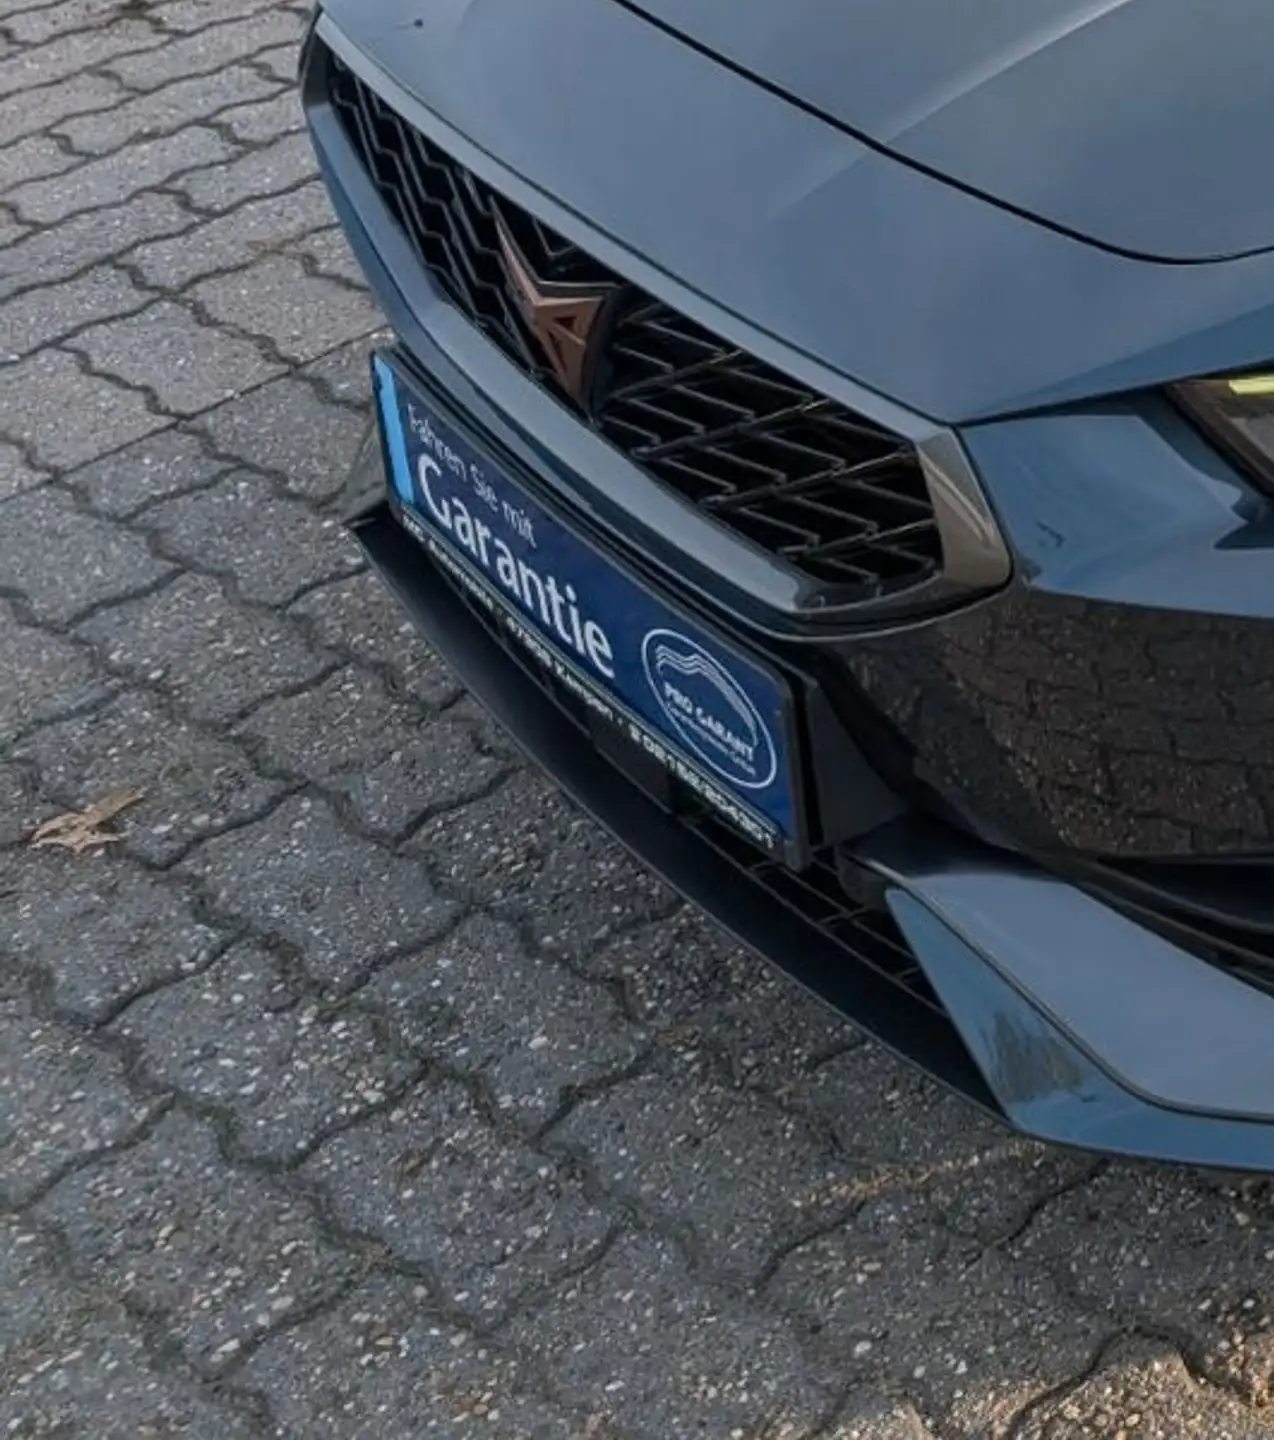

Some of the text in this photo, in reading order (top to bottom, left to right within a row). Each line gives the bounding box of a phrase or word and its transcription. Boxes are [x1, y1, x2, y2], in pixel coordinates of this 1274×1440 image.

[408, 403, 537, 548] Fahren Sie mit
[417, 453, 615, 679] Garantie
[664, 680, 692, 713] PRO
